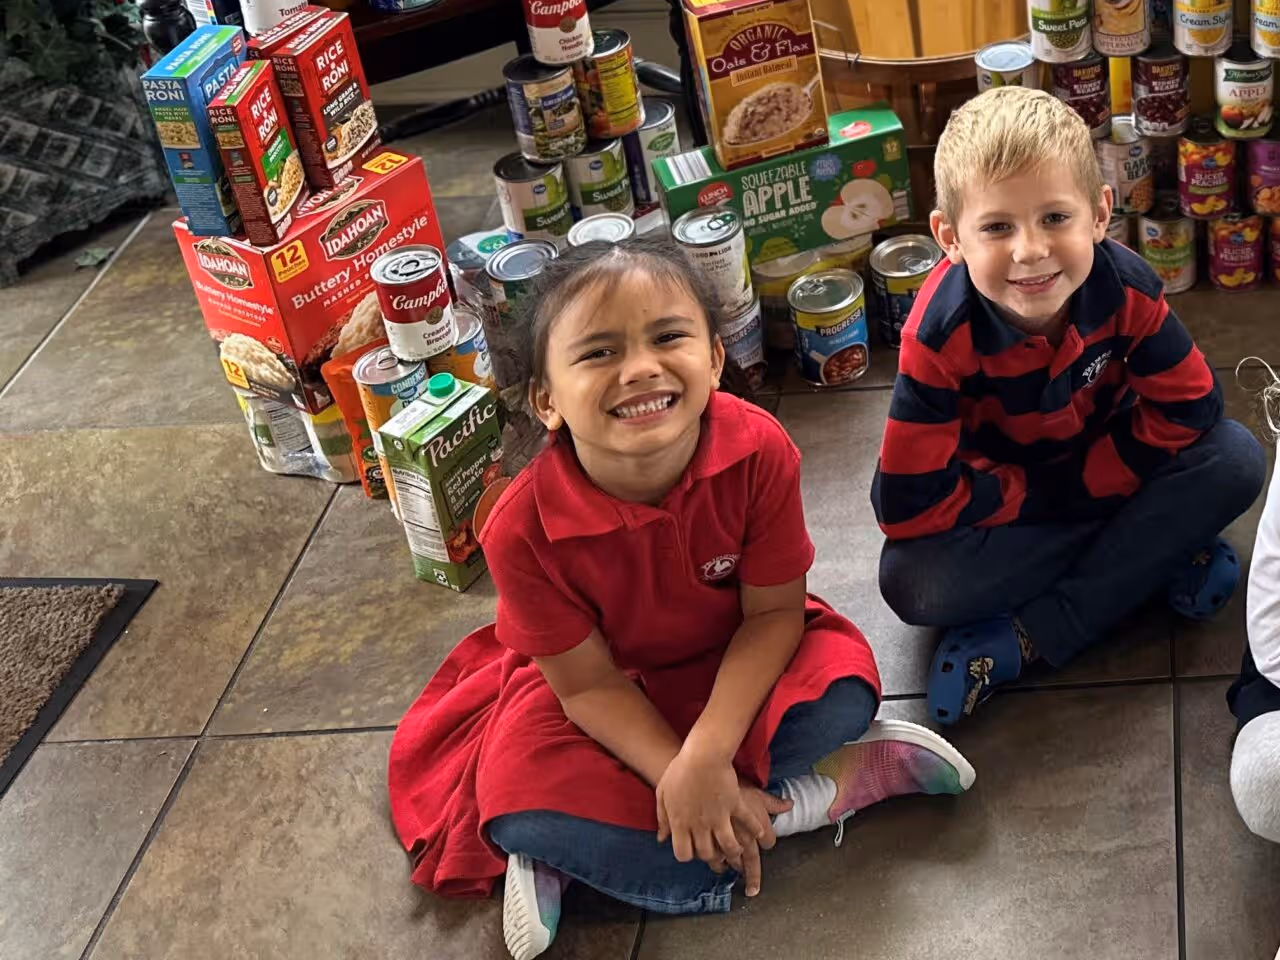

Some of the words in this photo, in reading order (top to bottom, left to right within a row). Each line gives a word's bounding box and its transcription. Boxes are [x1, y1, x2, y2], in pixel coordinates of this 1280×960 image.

[1038, 20, 1067, 31] Sweet
[1180, 15, 1210, 25] Cream
[729, 26, 786, 51] ORGANIC
[315, 40, 344, 71] RICE
[711, 56, 746, 73] Oats
[750, 42, 771, 62] &
[775, 39, 809, 55] Flax
[143, 81, 182, 89] PASTA
[322, 60, 348, 91] RONI
[145, 91, 184, 101] RONI
[251, 87, 271, 119] RICE
[323, 100, 338, 115] LONG
[338, 87, 353, 102] GRAIN
[330, 104, 343, 116] WILD
[258, 109, 278, 140] RONI
[741, 161, 807, 191] SQUEEZABLE
[700, 186, 729, 205] LUNCH
[742, 177, 812, 218] APPLE
[757, 209, 785, 224] SUGAR
[786, 201, 817, 219] ADDED
[325, 204, 385, 256] IDAHOAN
[199, 254, 248, 277] IDAHOAN
[276, 246, 300, 265] 12
[291, 268, 351, 310] Buttery
[354, 214, 428, 269] Homestyle
[224, 293, 274, 314] Homestyle
[423, 324, 444, 341] Cream
[820, 308, 862, 337] PROGRESSO
[225, 358, 242, 376] 12
[423, 404, 496, 467] Pacific
[462, 454, 487, 477] Pepper
[457, 468, 484, 495] Tomato
